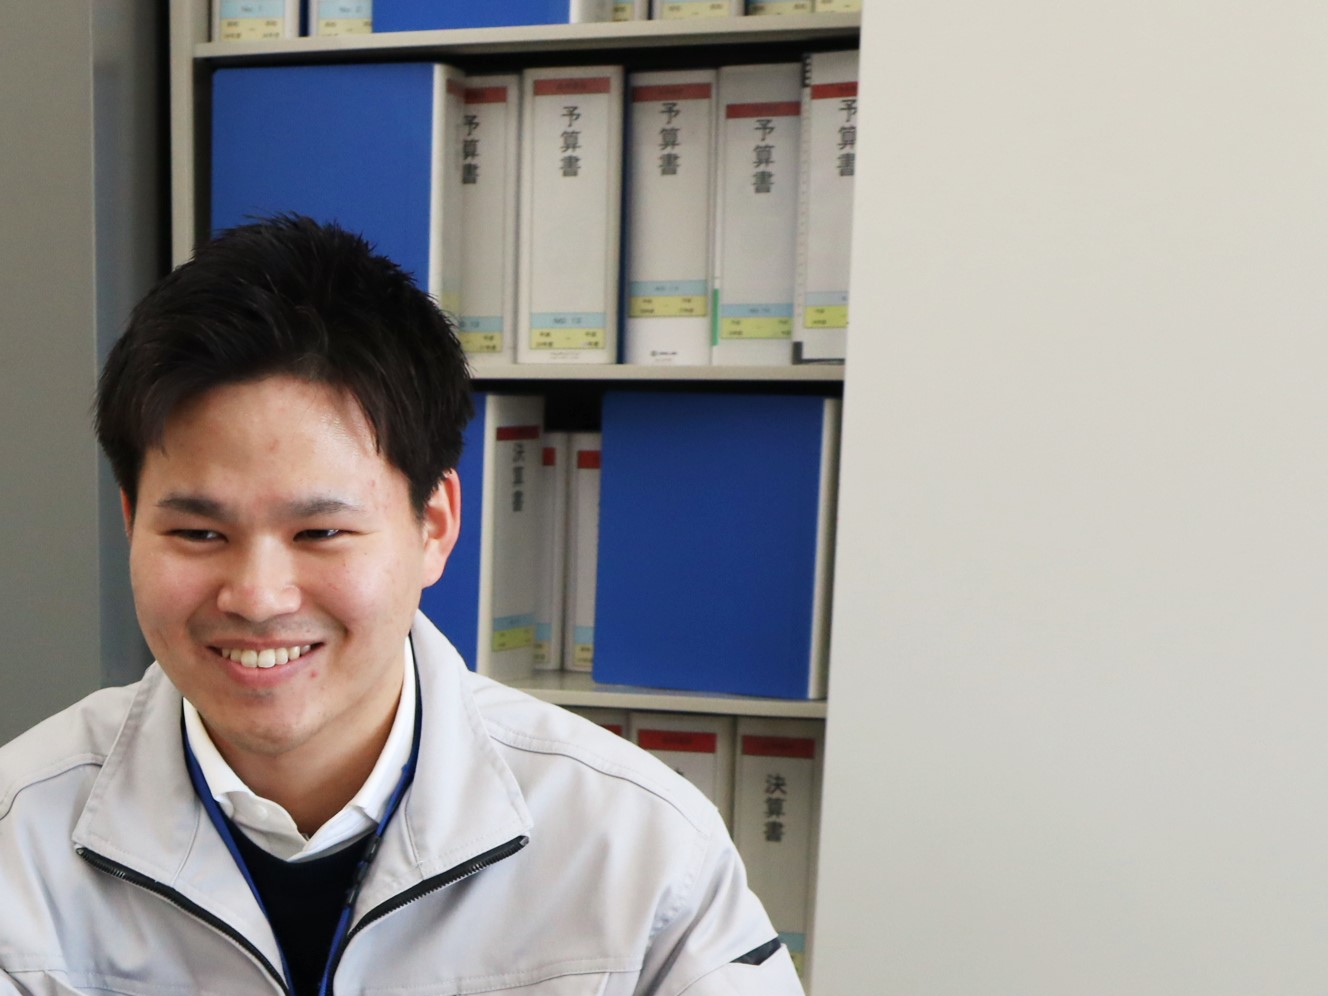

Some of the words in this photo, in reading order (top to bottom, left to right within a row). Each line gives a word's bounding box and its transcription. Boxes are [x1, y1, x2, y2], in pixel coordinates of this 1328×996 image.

[462, 114, 479, 185] 予算書
[560, 106, 581, 178] 予算書
[658, 103, 681, 176] 予算書
[752, 119, 776, 194] 予算書
[764, 774, 787, 843] 決算書
